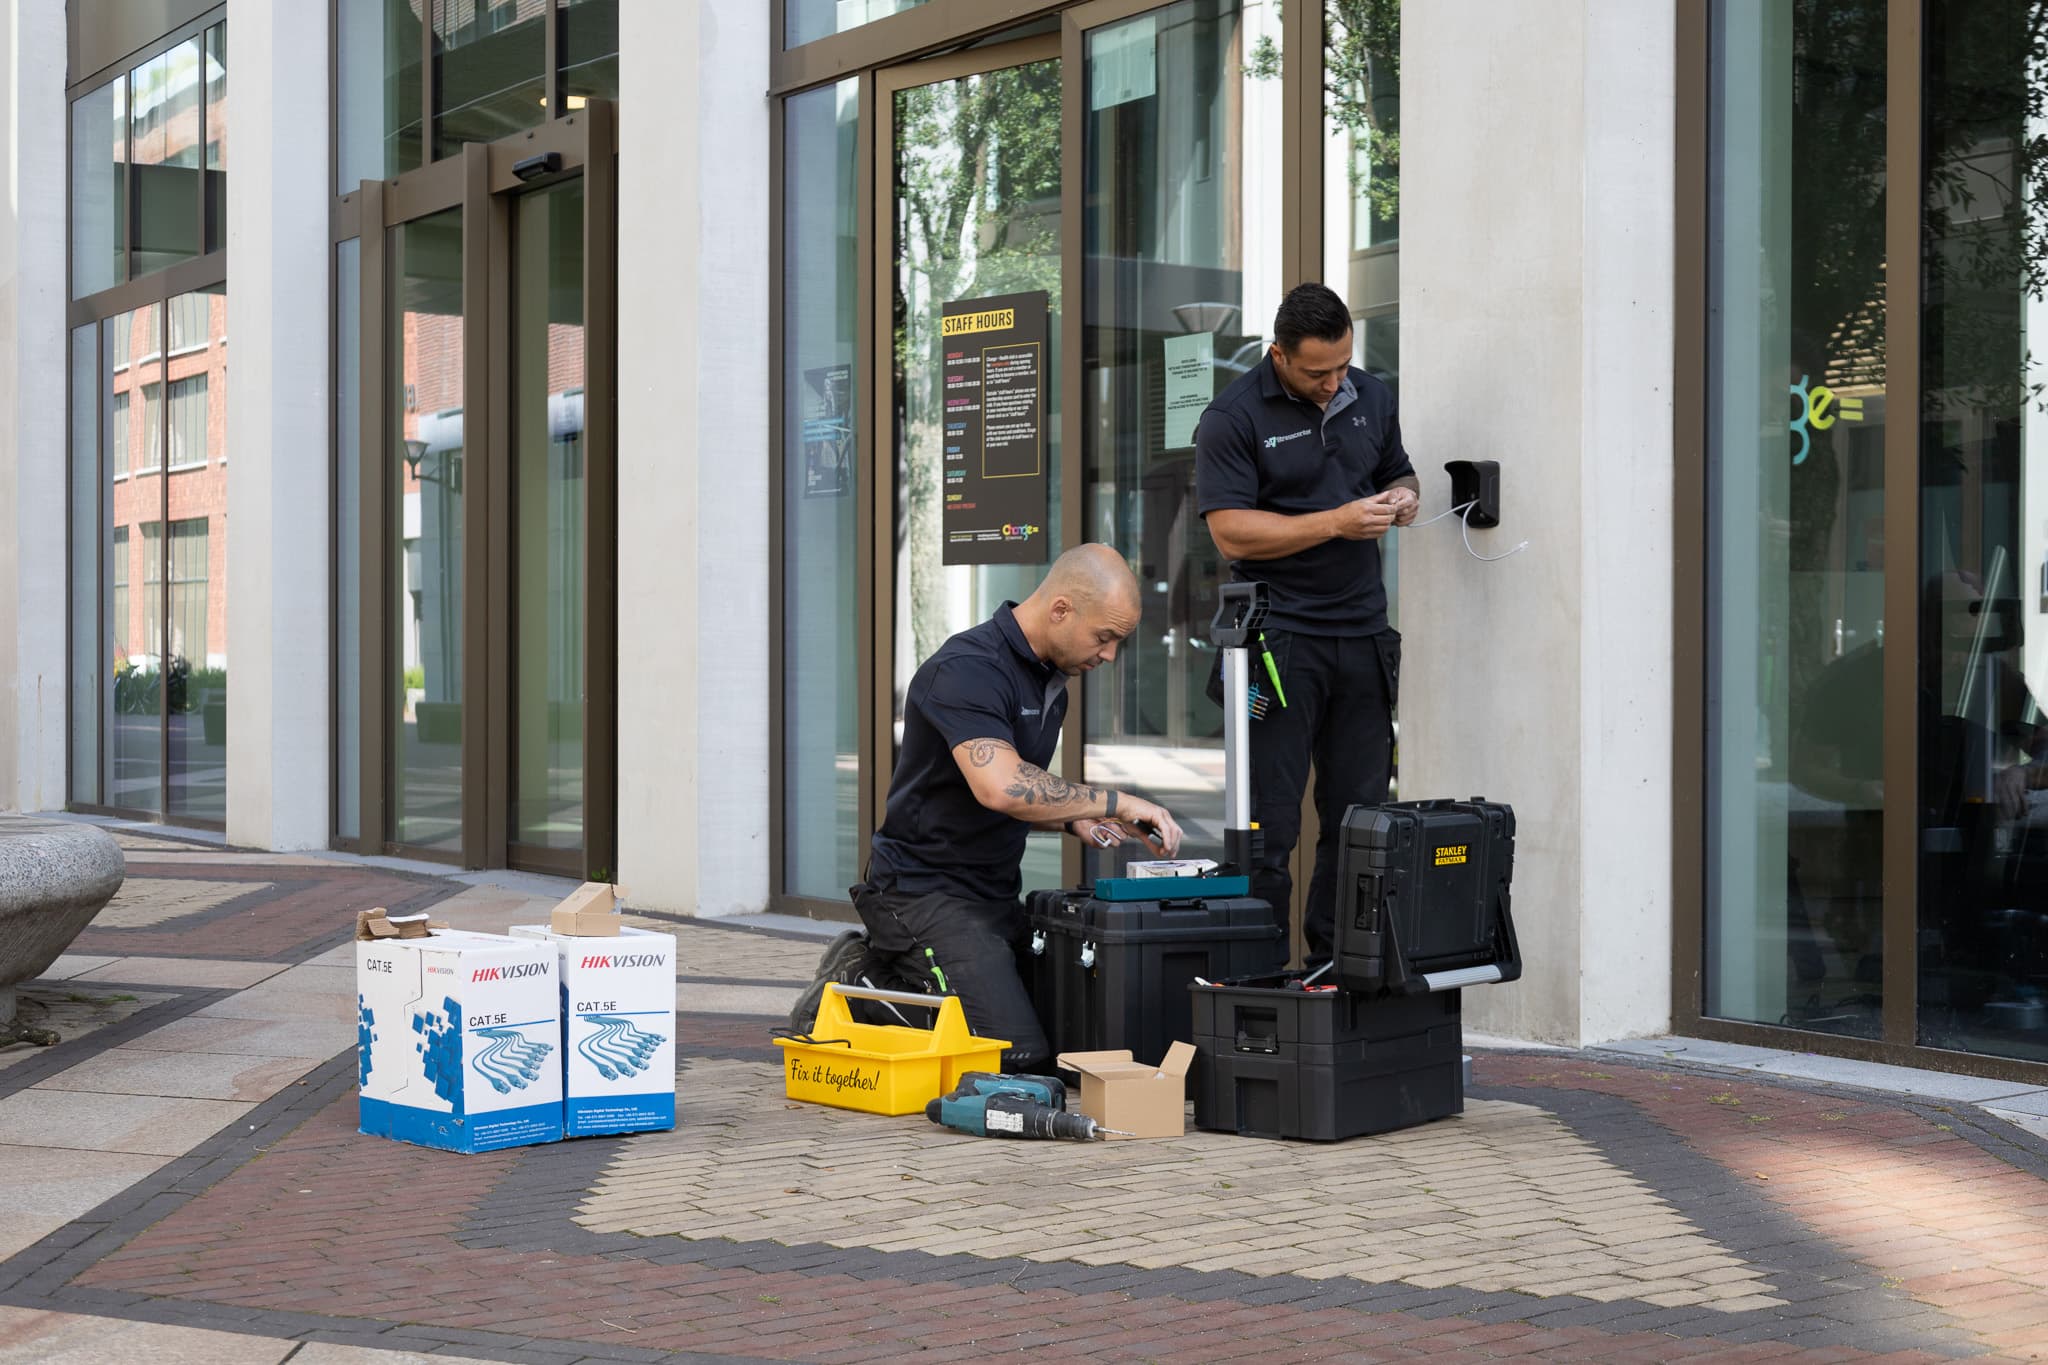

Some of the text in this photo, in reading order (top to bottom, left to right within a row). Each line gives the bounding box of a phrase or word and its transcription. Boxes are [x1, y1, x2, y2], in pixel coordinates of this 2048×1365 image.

[944, 311, 1013, 333] STAFF HOURS
[1435, 845, 1467, 857] STANLEY
[367, 958, 393, 974] CAT.5E
[580, 953, 666, 969] HIKVISION
[427, 966, 455, 976] HIKVISION
[471, 962, 550, 983] HIKVISION
[576, 1001, 617, 1012] CAT.5E
[469, 1013, 508, 1027] CAT.5E
[791, 1058, 881, 1093] Fix it together!
